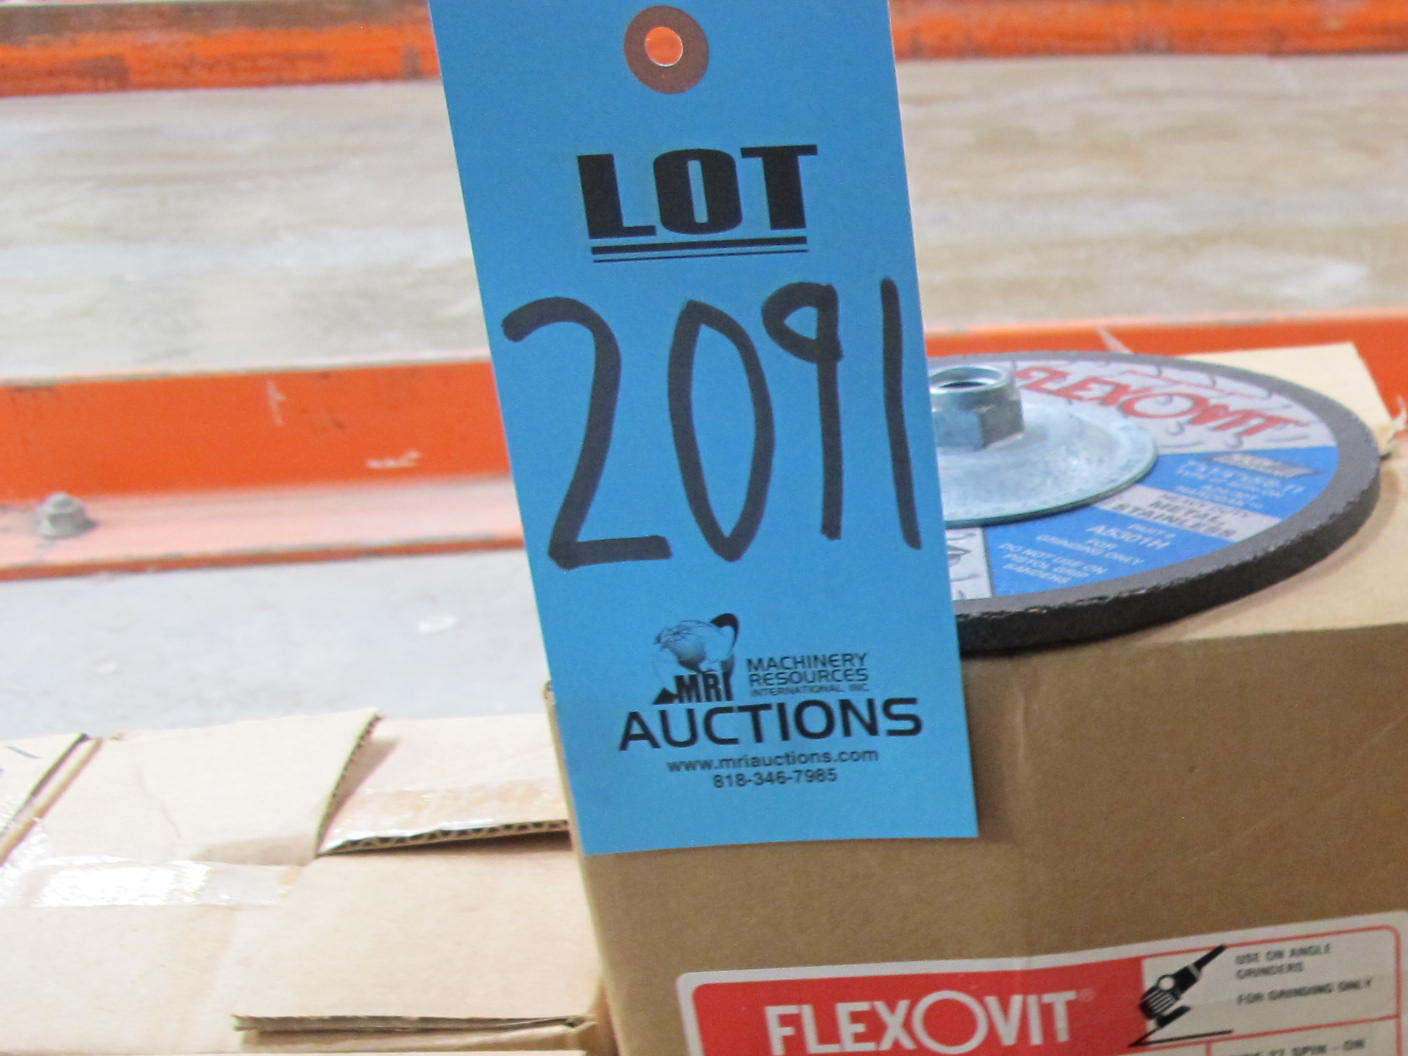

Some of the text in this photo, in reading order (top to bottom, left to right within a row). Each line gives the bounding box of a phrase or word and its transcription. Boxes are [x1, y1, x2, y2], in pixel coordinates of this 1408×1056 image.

[577, 144, 817, 240] LOT
[1013, 364, 1307, 437] FLEXOVIT
[502, 277, 922, 571] 2091
[746, 652, 868, 673] MACHINERY
[749, 667, 869, 687] RESOURCES
[675, 672, 734, 704] MRI
[619, 697, 923, 752] AUCTIONS
[667, 748, 880, 773] www.mriauctions.com
[713, 767, 838, 789] 818-346-7985
[1337, 976, 1375, 994] ONLY
[764, 989, 1079, 1056] FLEXOVIT
